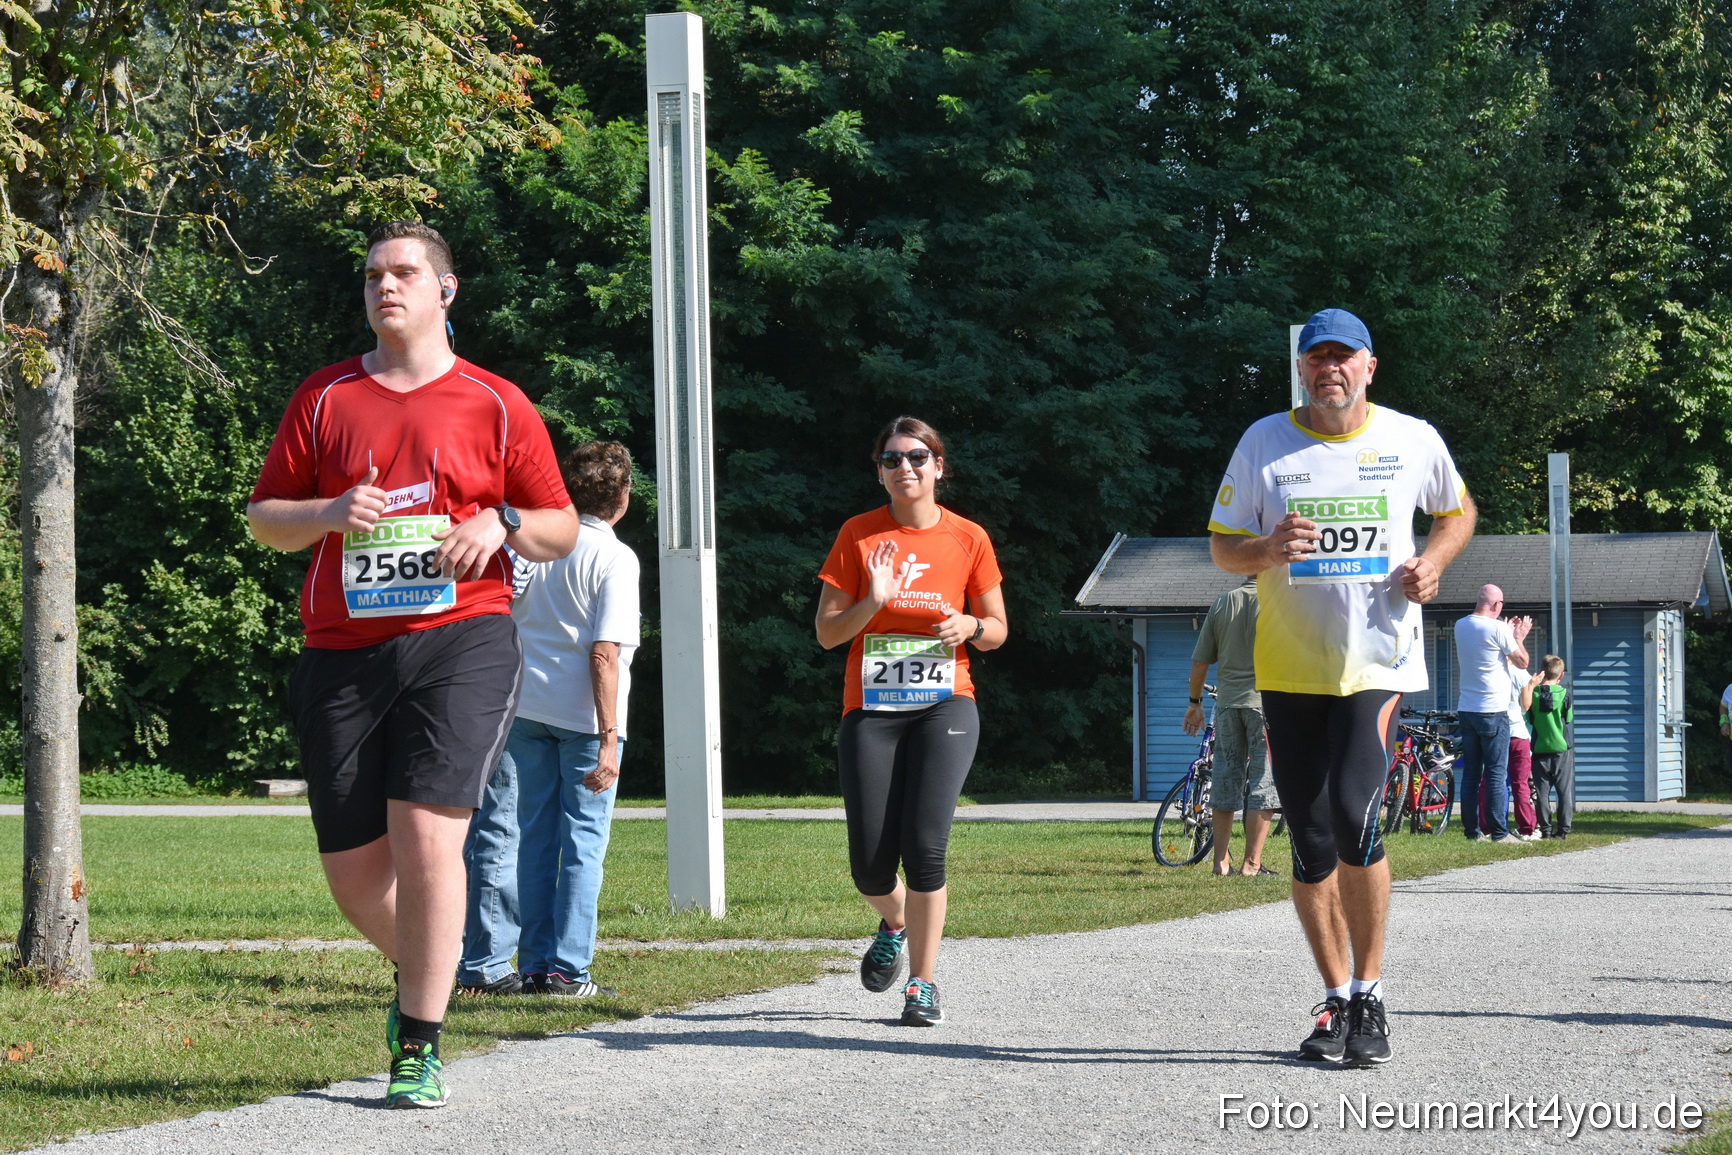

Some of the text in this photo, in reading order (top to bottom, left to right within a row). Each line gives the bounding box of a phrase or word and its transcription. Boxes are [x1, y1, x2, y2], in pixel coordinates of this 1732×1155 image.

[1359, 452, 1377, 464] 20
[1358, 464, 1404, 473] Neumarkter
[1276, 473, 1311, 483] BOCK
[1358, 473, 1396, 481] Stadtlauf
[1295, 500, 1380, 519] BOCK
[351, 522, 434, 545] BOCK
[1300, 526, 1378, 554] 097
[355, 550, 442, 584] 2568
[1318, 561, 1362, 574] HANS
[357, 589, 442, 607] MATTHIAS
[895, 590, 942, 601] runners
[893, 600, 951, 610] neumarkt
[871, 638, 946, 656] BOCK
[873, 661, 943, 684] 2134
[878, 691, 938, 702] MELANIE
